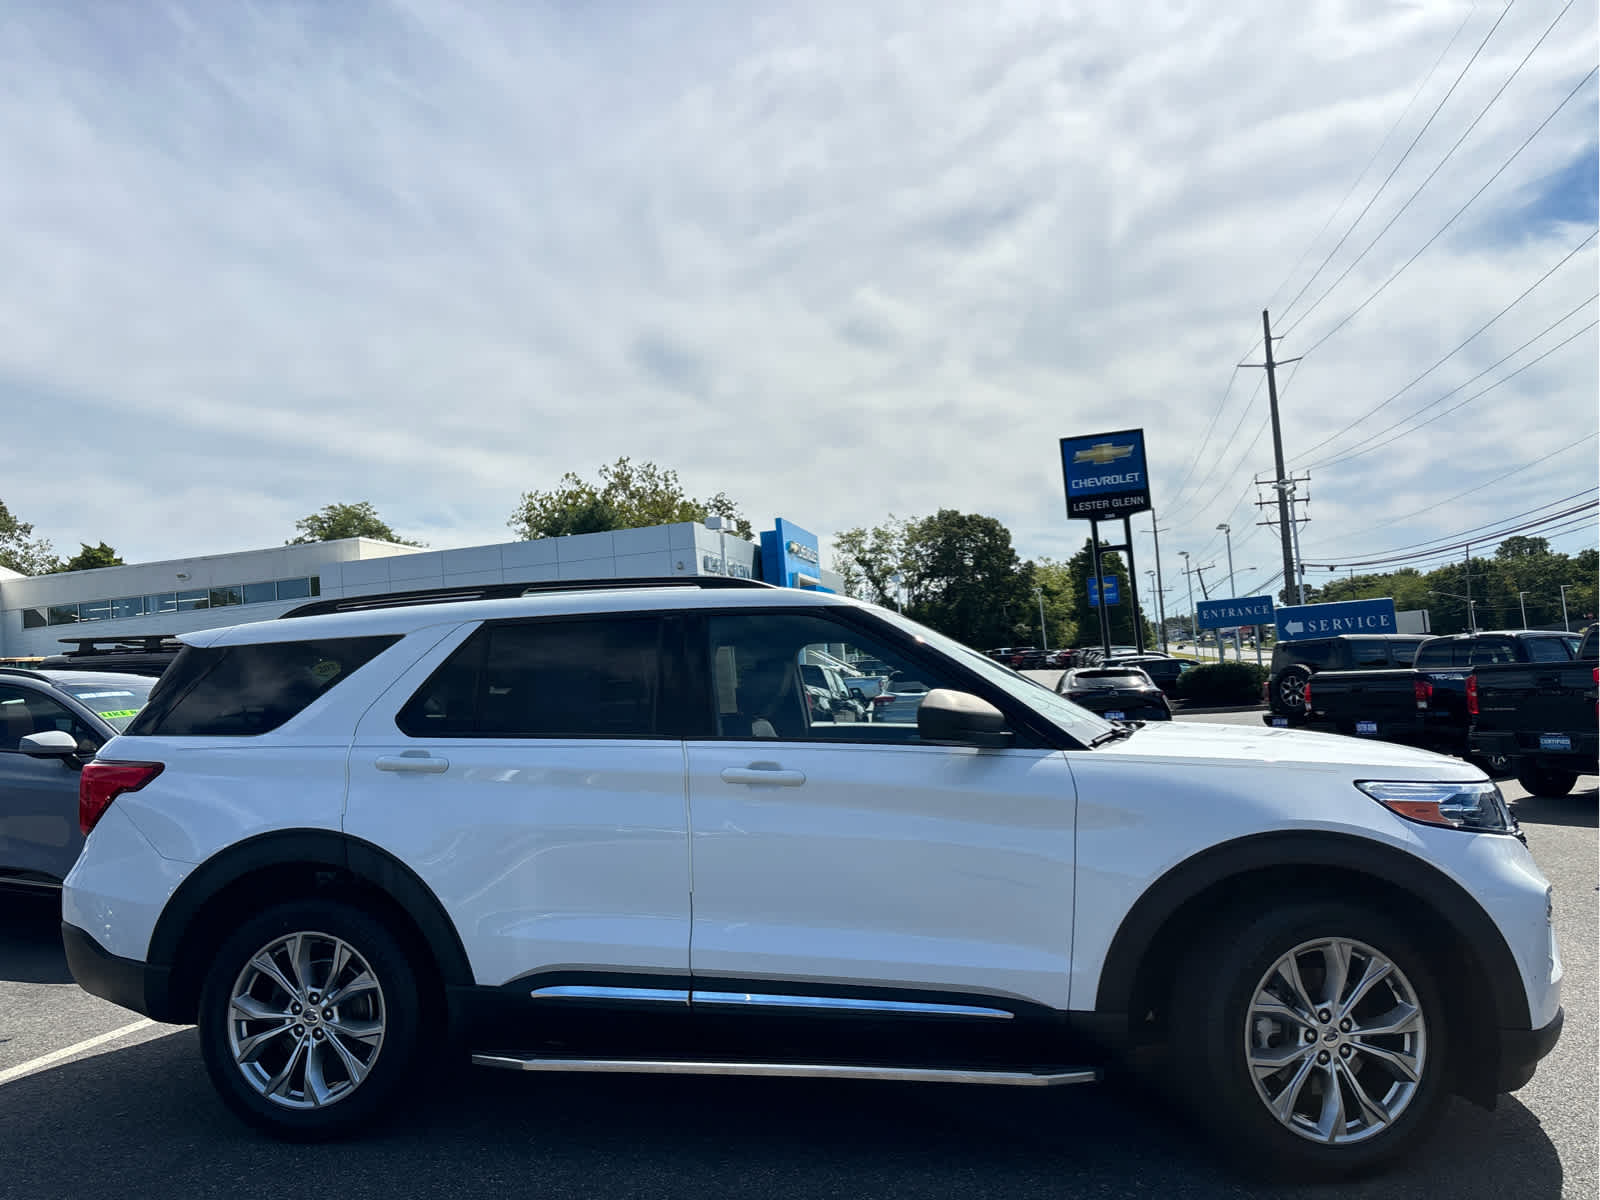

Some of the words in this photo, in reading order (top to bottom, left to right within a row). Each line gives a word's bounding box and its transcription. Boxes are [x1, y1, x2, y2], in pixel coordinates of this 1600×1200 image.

[1071, 472, 1140, 489] CHEVROLET
[1073, 499, 1110, 512] LESTER
[1111, 496, 1145, 508] GLENN
[1202, 605, 1270, 620] ENTRANCE
[1307, 614, 1391, 633] SERVICE
